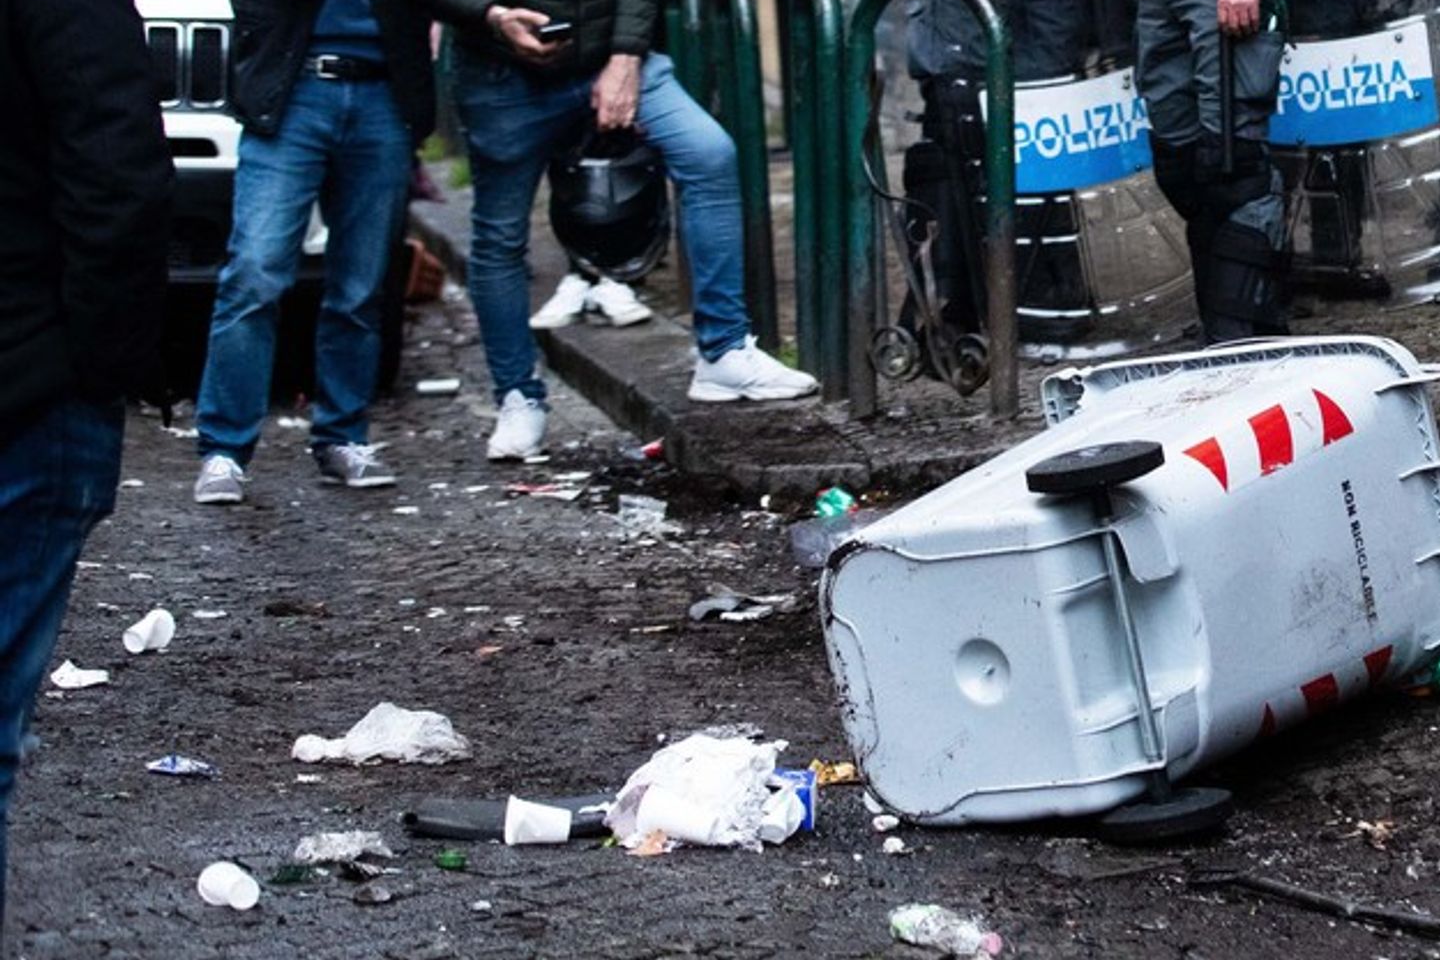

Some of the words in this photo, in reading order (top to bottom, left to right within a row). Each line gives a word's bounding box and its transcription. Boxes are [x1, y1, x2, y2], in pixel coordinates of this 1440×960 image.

[1277, 60, 1414, 115] POLIZIA
[1014, 97, 1151, 165] POLIZIA
[1341, 479, 1358, 518] NON
